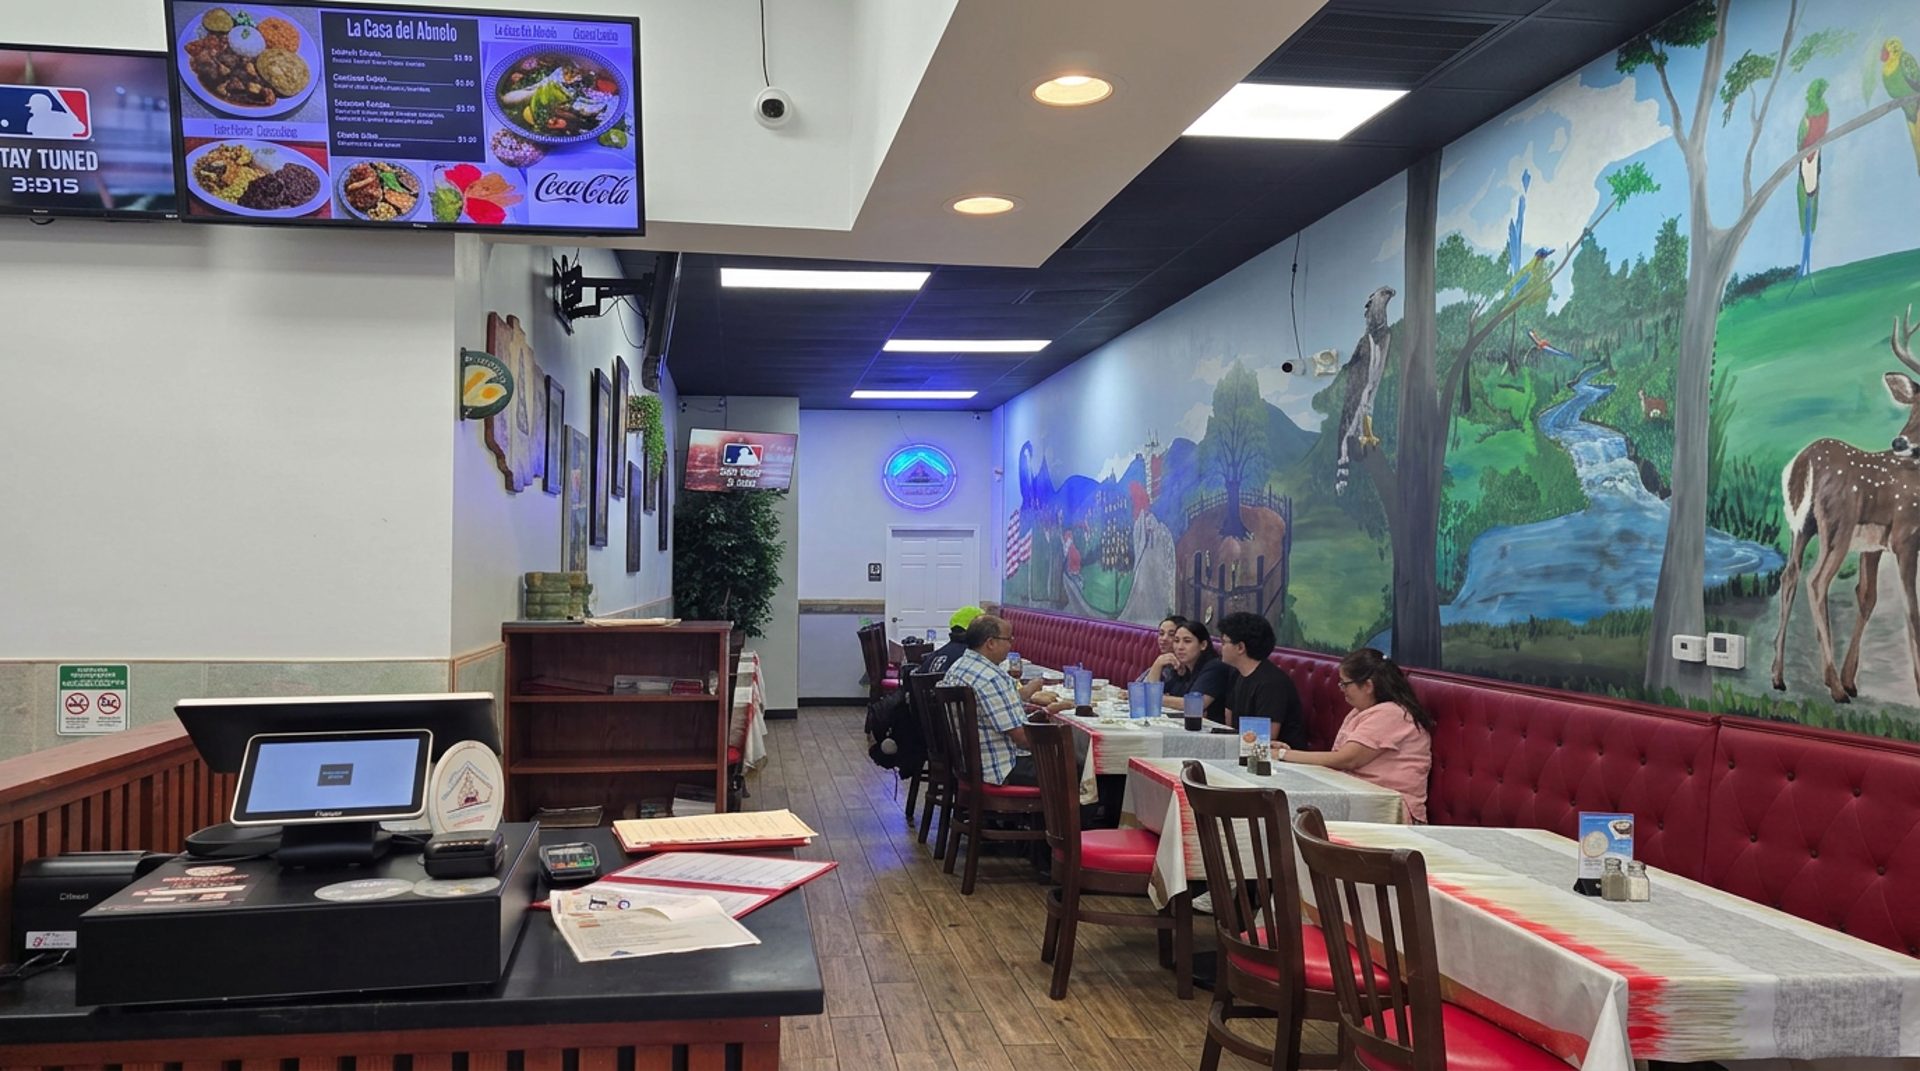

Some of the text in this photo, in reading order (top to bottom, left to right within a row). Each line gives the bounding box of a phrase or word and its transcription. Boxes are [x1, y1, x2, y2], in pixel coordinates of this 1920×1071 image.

[347, 17, 361, 37] La
[364, 18, 393, 39] Casa
[396, 20, 414, 40] del
[37, 148, 99, 171] TUNED
